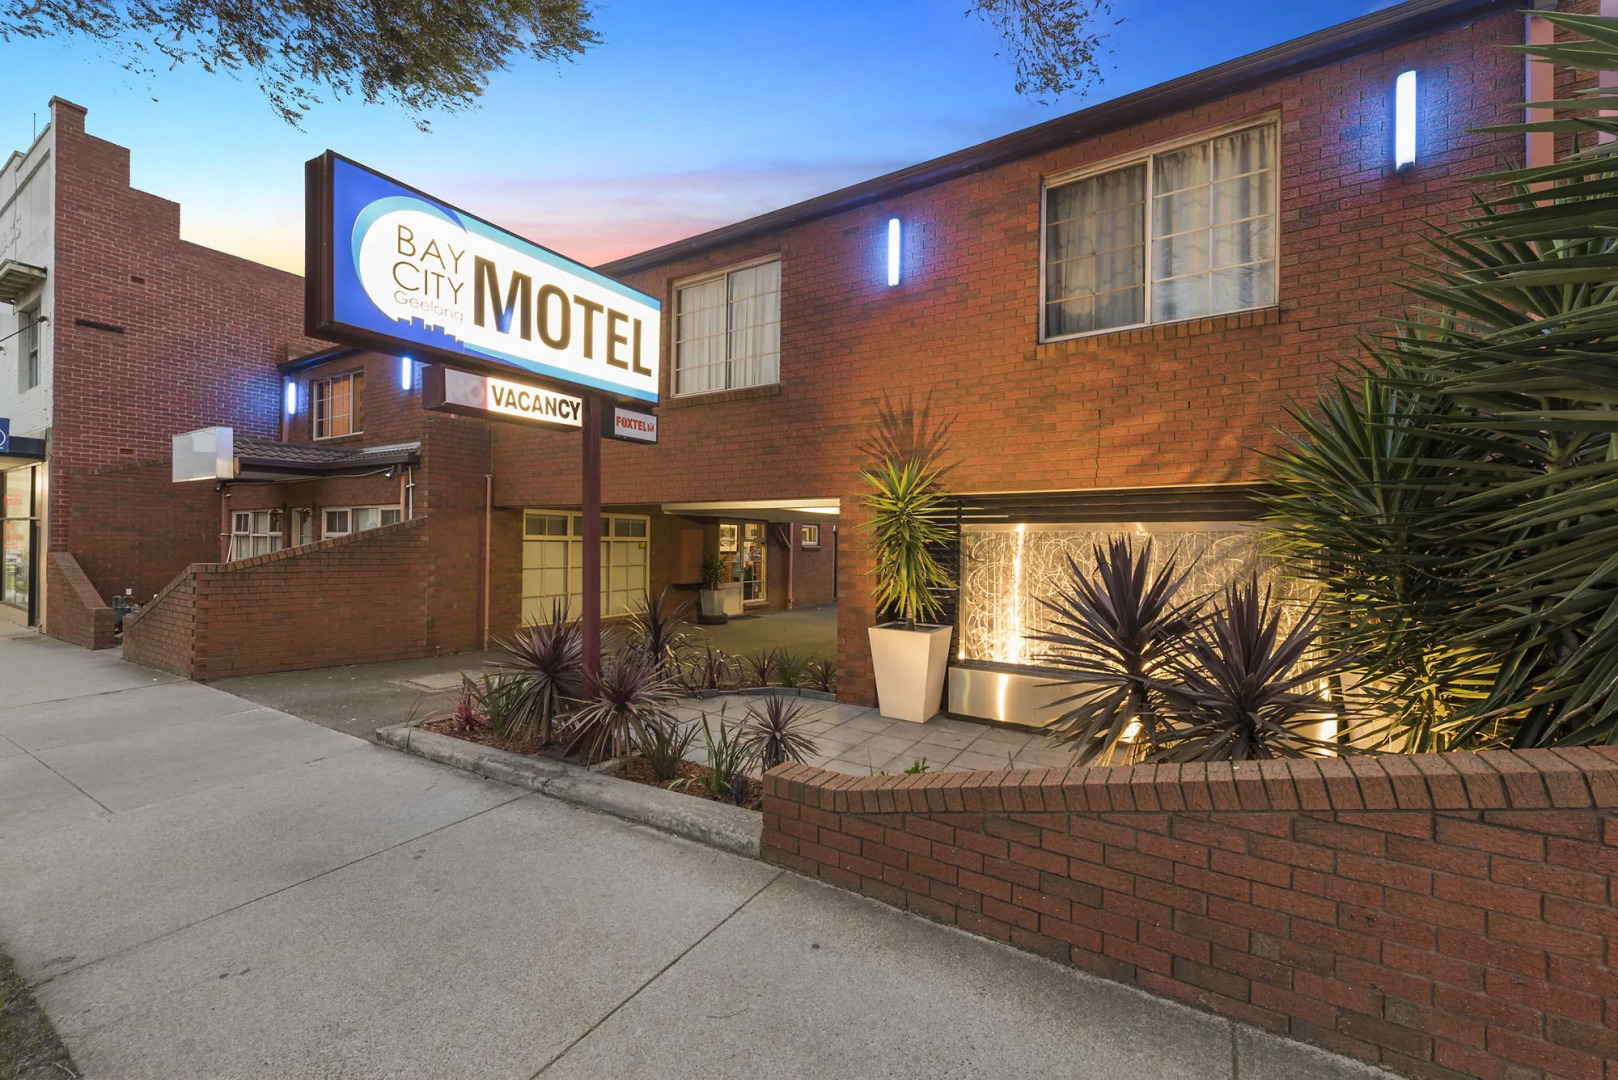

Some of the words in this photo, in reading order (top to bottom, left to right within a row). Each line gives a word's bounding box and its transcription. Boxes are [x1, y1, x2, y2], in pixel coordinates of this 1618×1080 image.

[398, 224, 465, 274] BAY
[393, 261, 464, 304] CITY
[394, 290, 464, 324] Geelong
[474, 255, 652, 377] MOTEL
[492, 385, 581, 420] VACANCY
[616, 416, 647, 432] FOXTEL
